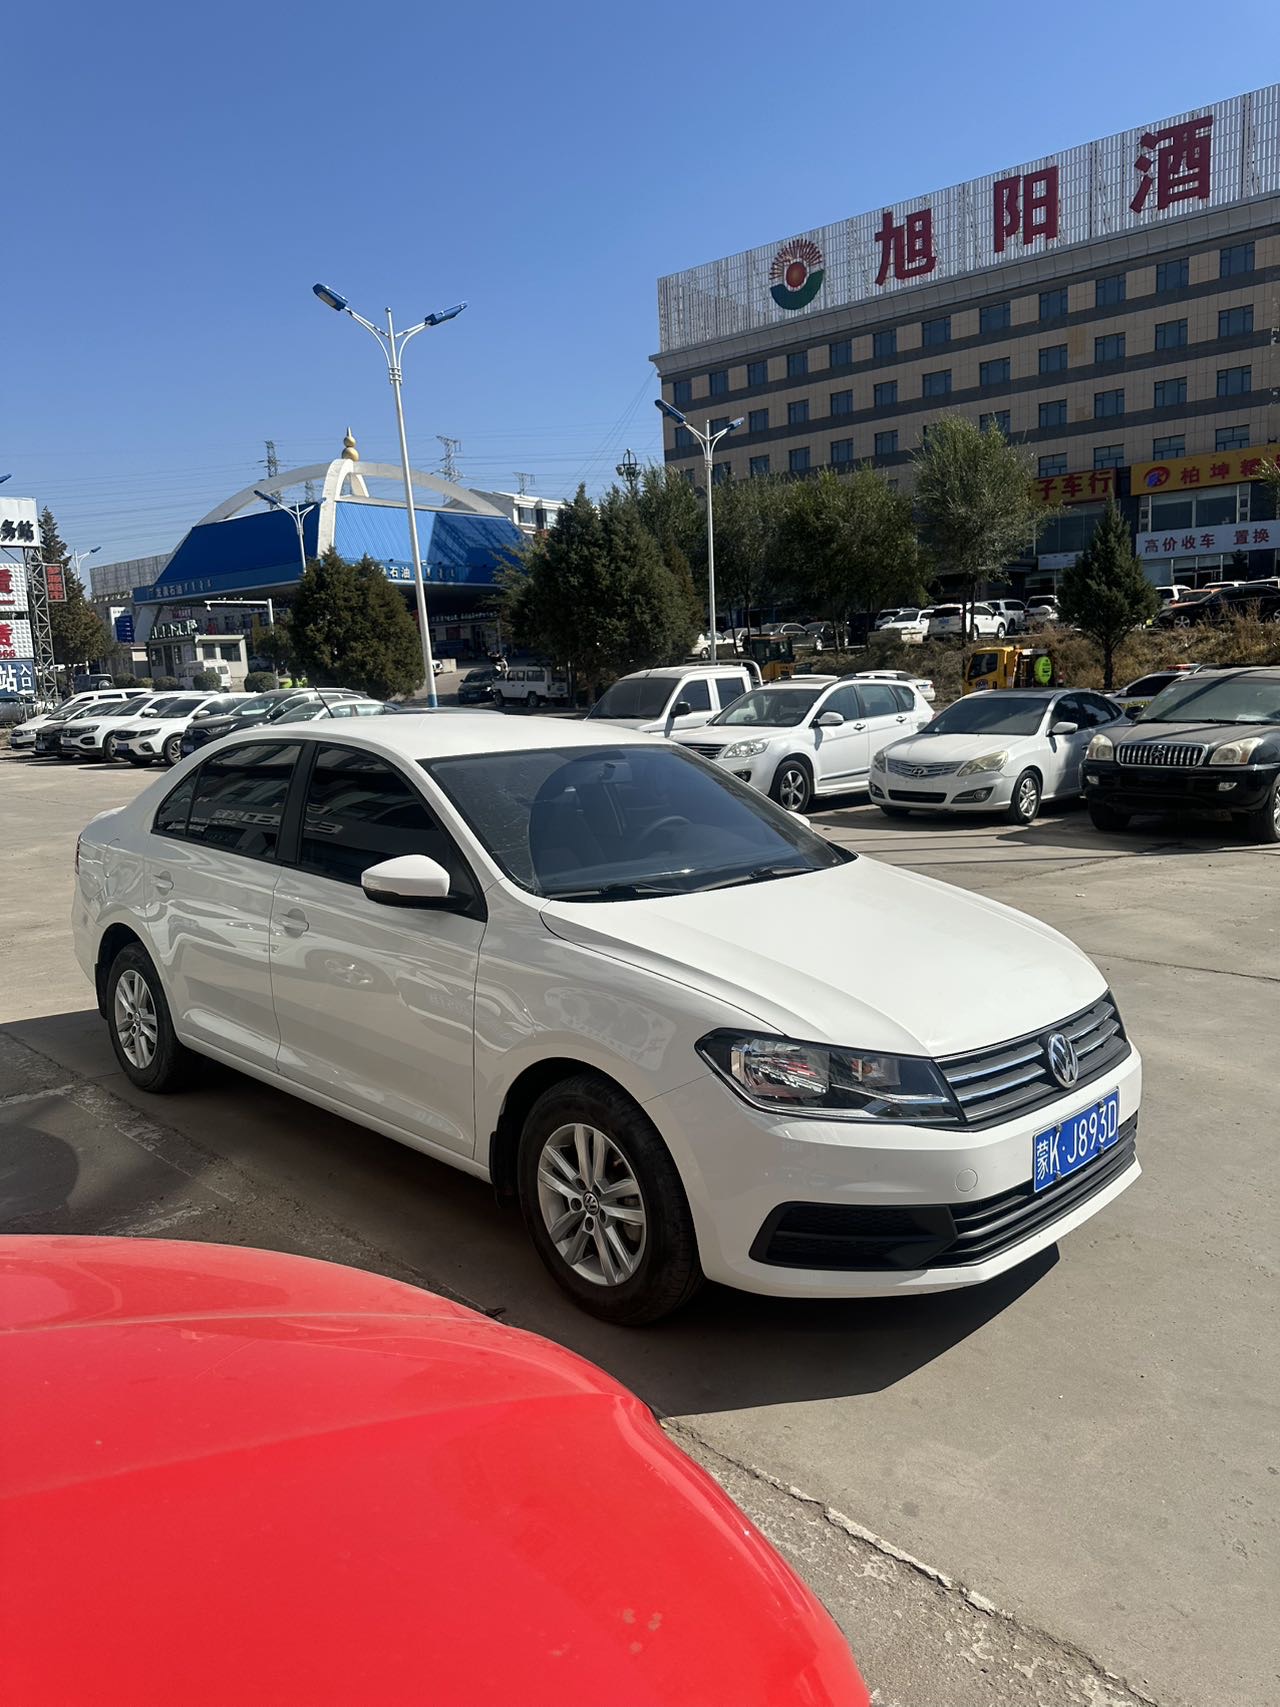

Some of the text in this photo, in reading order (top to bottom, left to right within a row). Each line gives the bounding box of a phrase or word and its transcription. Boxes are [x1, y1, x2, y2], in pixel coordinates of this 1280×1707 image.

[875, 115, 1213, 285] 旭阳酒
[0, 519, 34, 542] 务站
[1144, 528, 1270, 554] 高价收车 置换
